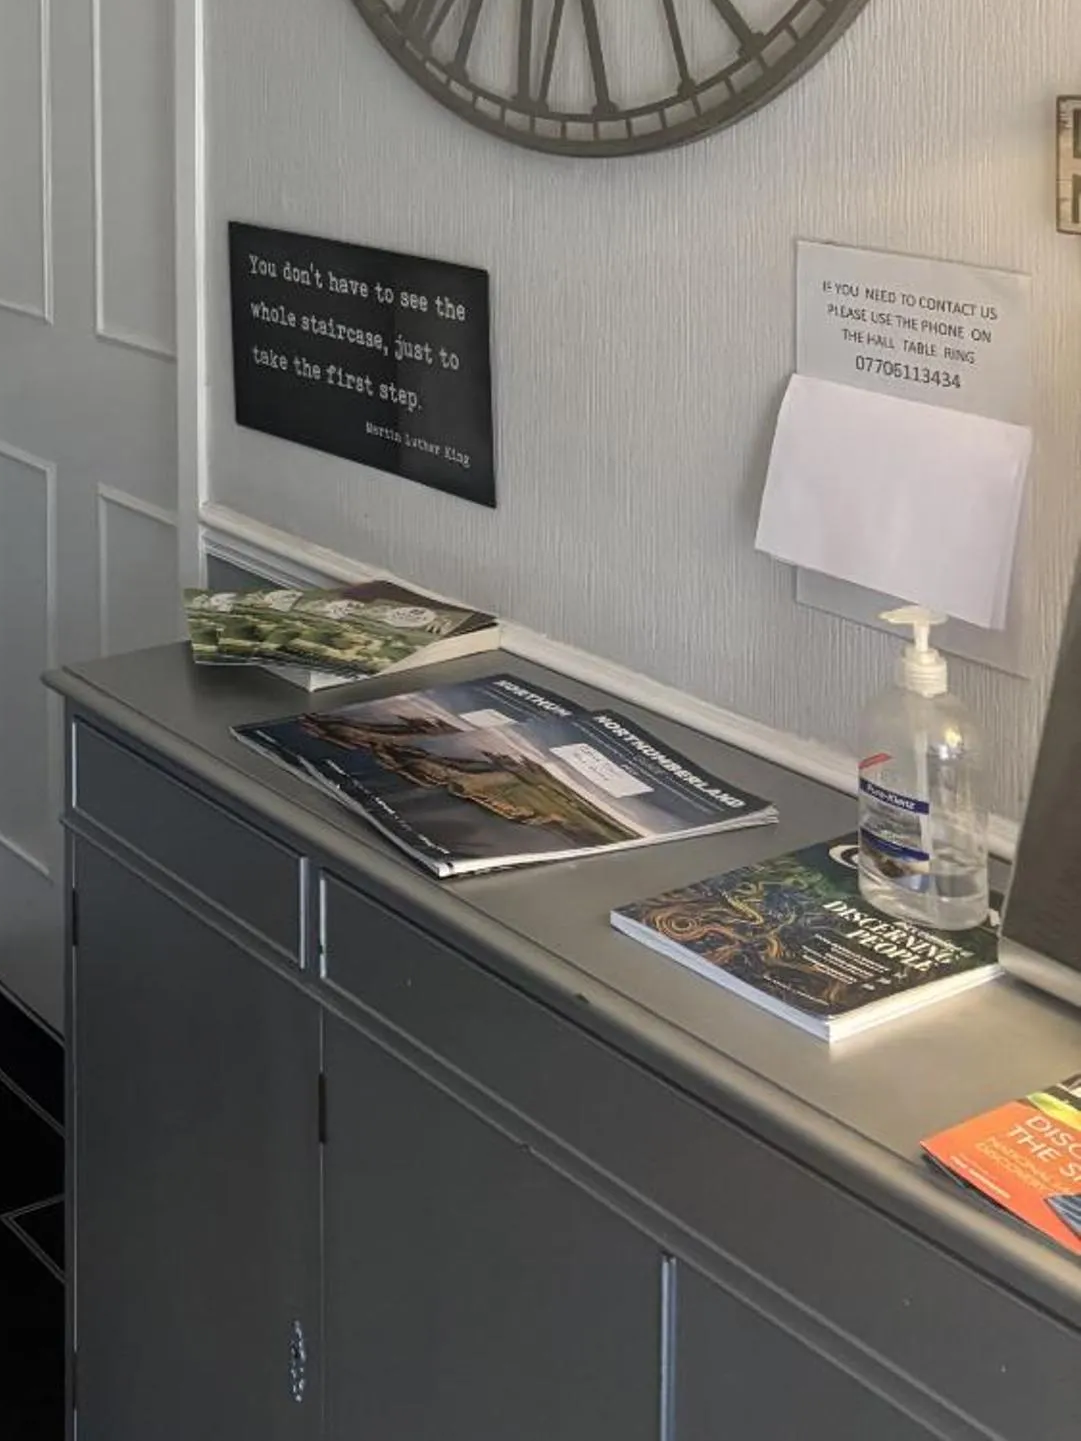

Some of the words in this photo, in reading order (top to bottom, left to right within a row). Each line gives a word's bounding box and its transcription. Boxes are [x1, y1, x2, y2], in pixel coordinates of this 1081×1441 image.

[248, 253, 278, 278] You
[282, 261, 324, 289] don't
[328, 270, 369, 299] have
[373, 282, 395, 305] to
[399, 291, 429, 313] see
[434, 294, 467, 322] the
[822, 280, 833, 293] IF
[834, 282, 861, 298] YOU
[865, 287, 897, 305] NEED
[900, 293, 917, 308] TO
[918, 294, 977, 318] CONTACT
[979, 305, 999, 321] US
[250, 300, 297, 328] whole
[301, 313, 390, 357] staircase,
[393, 333, 433, 366] just
[438, 346, 461, 371] to
[826, 303, 868, 323] PLEASE
[870, 310, 894, 327] USE
[895, 314, 919, 332] THE
[921, 319, 966, 340] PHONE
[970, 327, 993, 344] ON
[841, 327, 865, 345] THE
[866, 333, 896, 350] HALL
[902, 339, 938, 358] TABLE
[943, 346, 976, 365] RING
[252, 345, 289, 371] take
[292, 356, 322, 381] the
[325, 365, 374, 397] first
[378, 381, 423, 414] step.
[365, 421, 402, 444] Martin
[443, 445, 472, 469] King
[592, 714, 748, 809] NORTHUMBERLAND
[822, 900, 956, 965] DISCERNING
[845, 928, 934, 973] PEOPLE
[1007, 1123, 1062, 1164] THE
